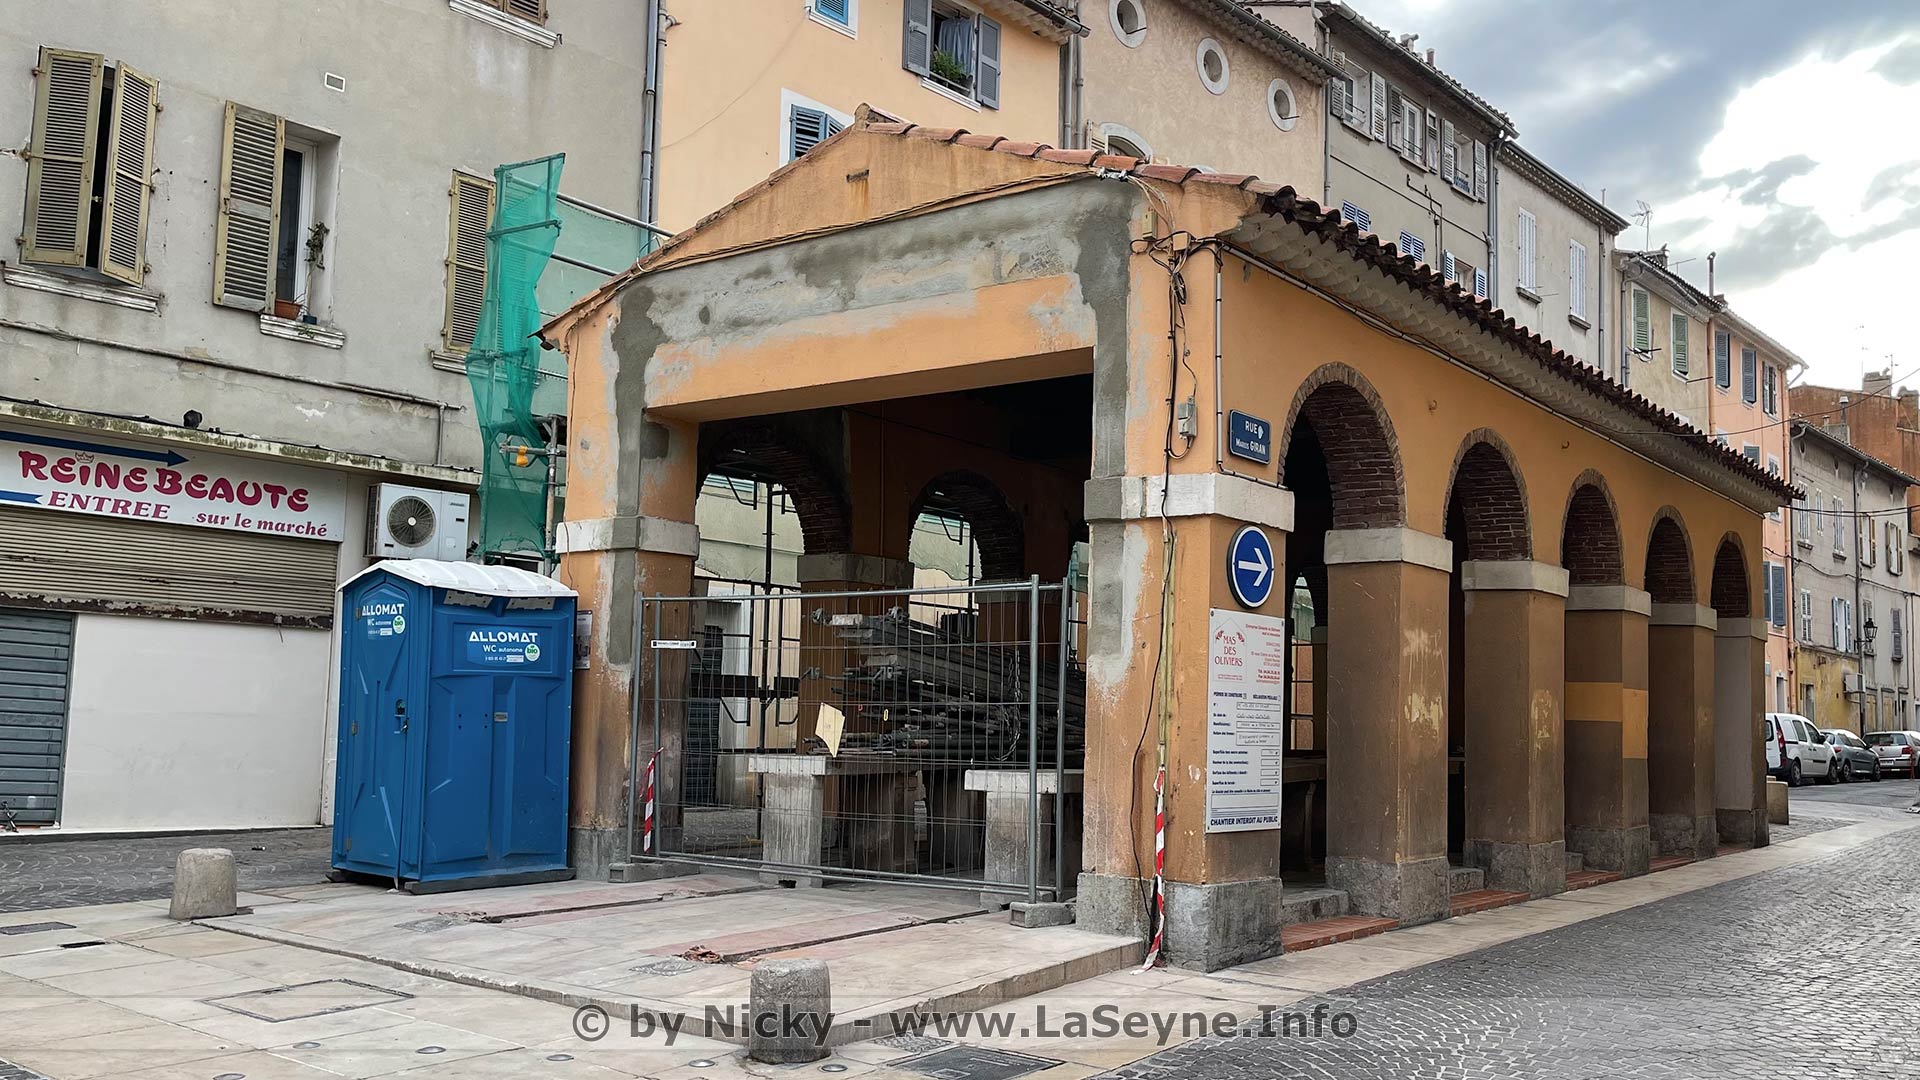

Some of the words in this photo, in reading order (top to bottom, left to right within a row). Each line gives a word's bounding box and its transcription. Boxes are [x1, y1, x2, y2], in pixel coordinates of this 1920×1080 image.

[1245, 420, 1258, 434] RUE
[18, 450, 148, 493] REINE
[153, 467, 310, 513] BEAUTE
[48, 490, 171, 520] ENTREE
[195, 512, 230, 527] sur
[234, 512, 252, 528] le
[257, 518, 328, 537] marché
[361, 603, 405, 616] ALLOMAT
[468, 631, 538, 643] ALLOMAT
[1223, 635, 1237, 645] MAS
[482, 644, 497, 653] WC
[1223, 646, 1237, 656] DES
[1214, 655, 1243, 667] OLIVIERS
[1210, 818, 1235, 826] CHANTIER
[1235, 817, 1256, 825] INTERDIT
[1256, 816, 1263, 824] AU
[1263, 815, 1278, 823] PUBLIC
